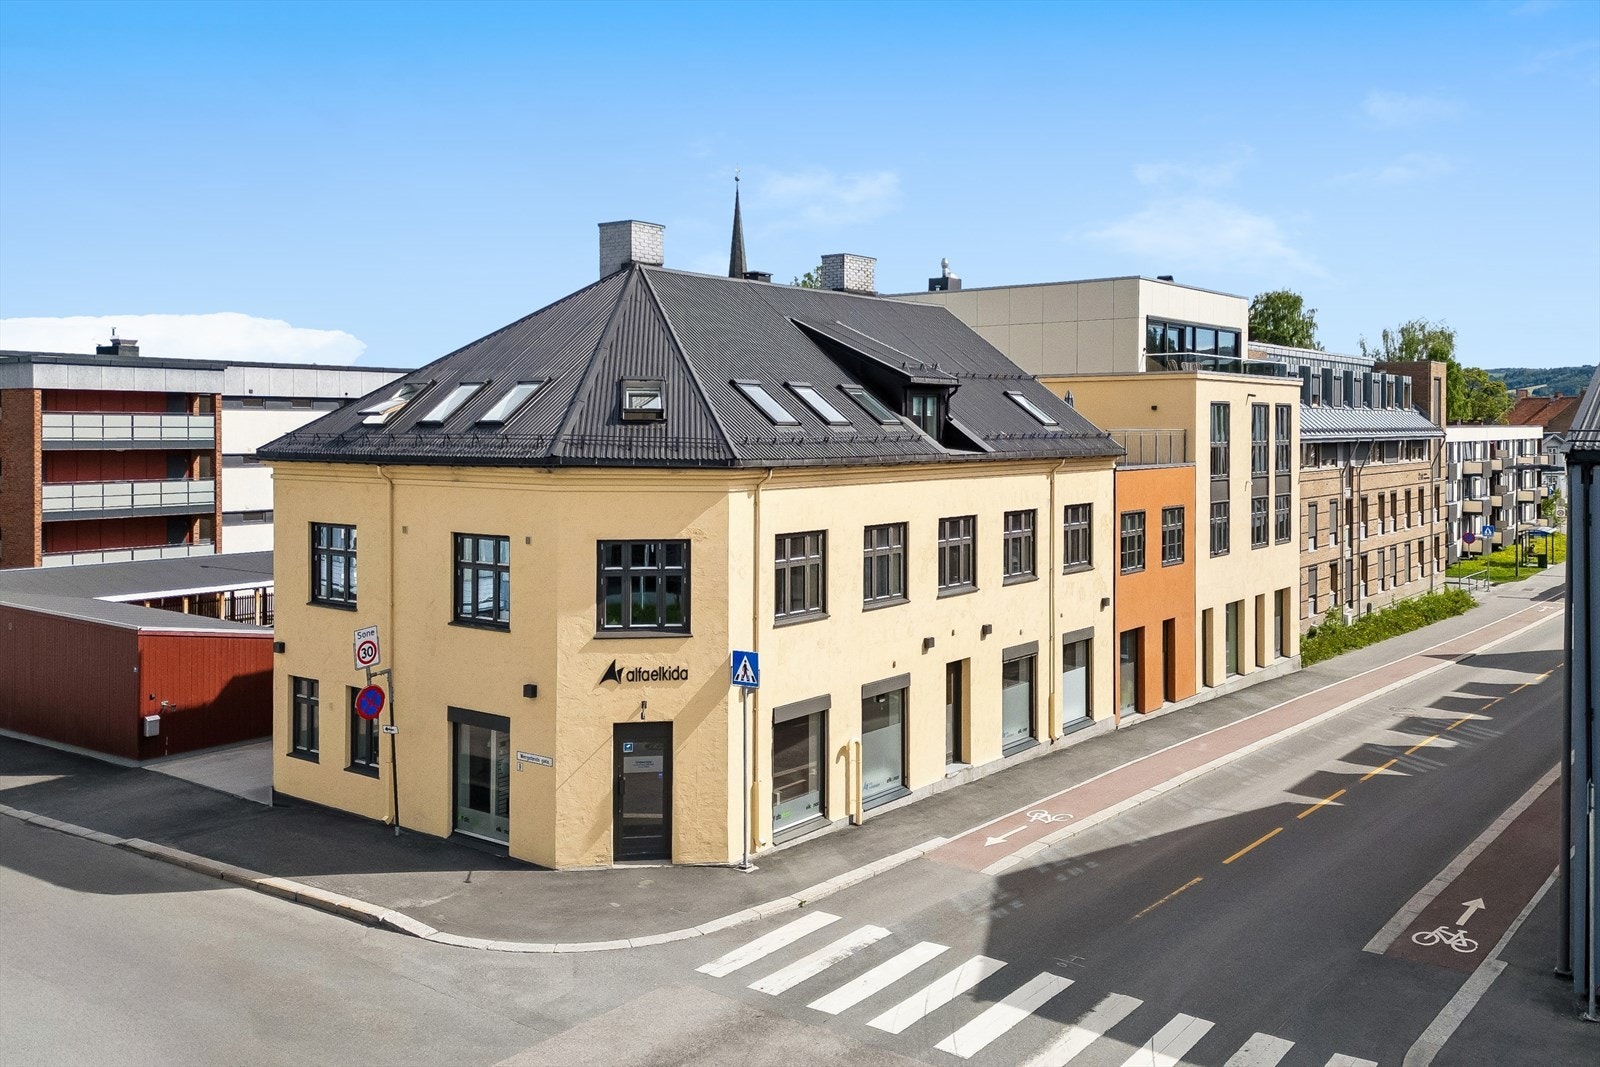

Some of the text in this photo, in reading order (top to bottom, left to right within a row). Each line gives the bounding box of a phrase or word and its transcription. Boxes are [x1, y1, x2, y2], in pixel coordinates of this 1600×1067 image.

[357, 630, 375, 640] Sone
[361, 646, 373, 659] 30
[626, 666, 688, 682] alfaelkida
